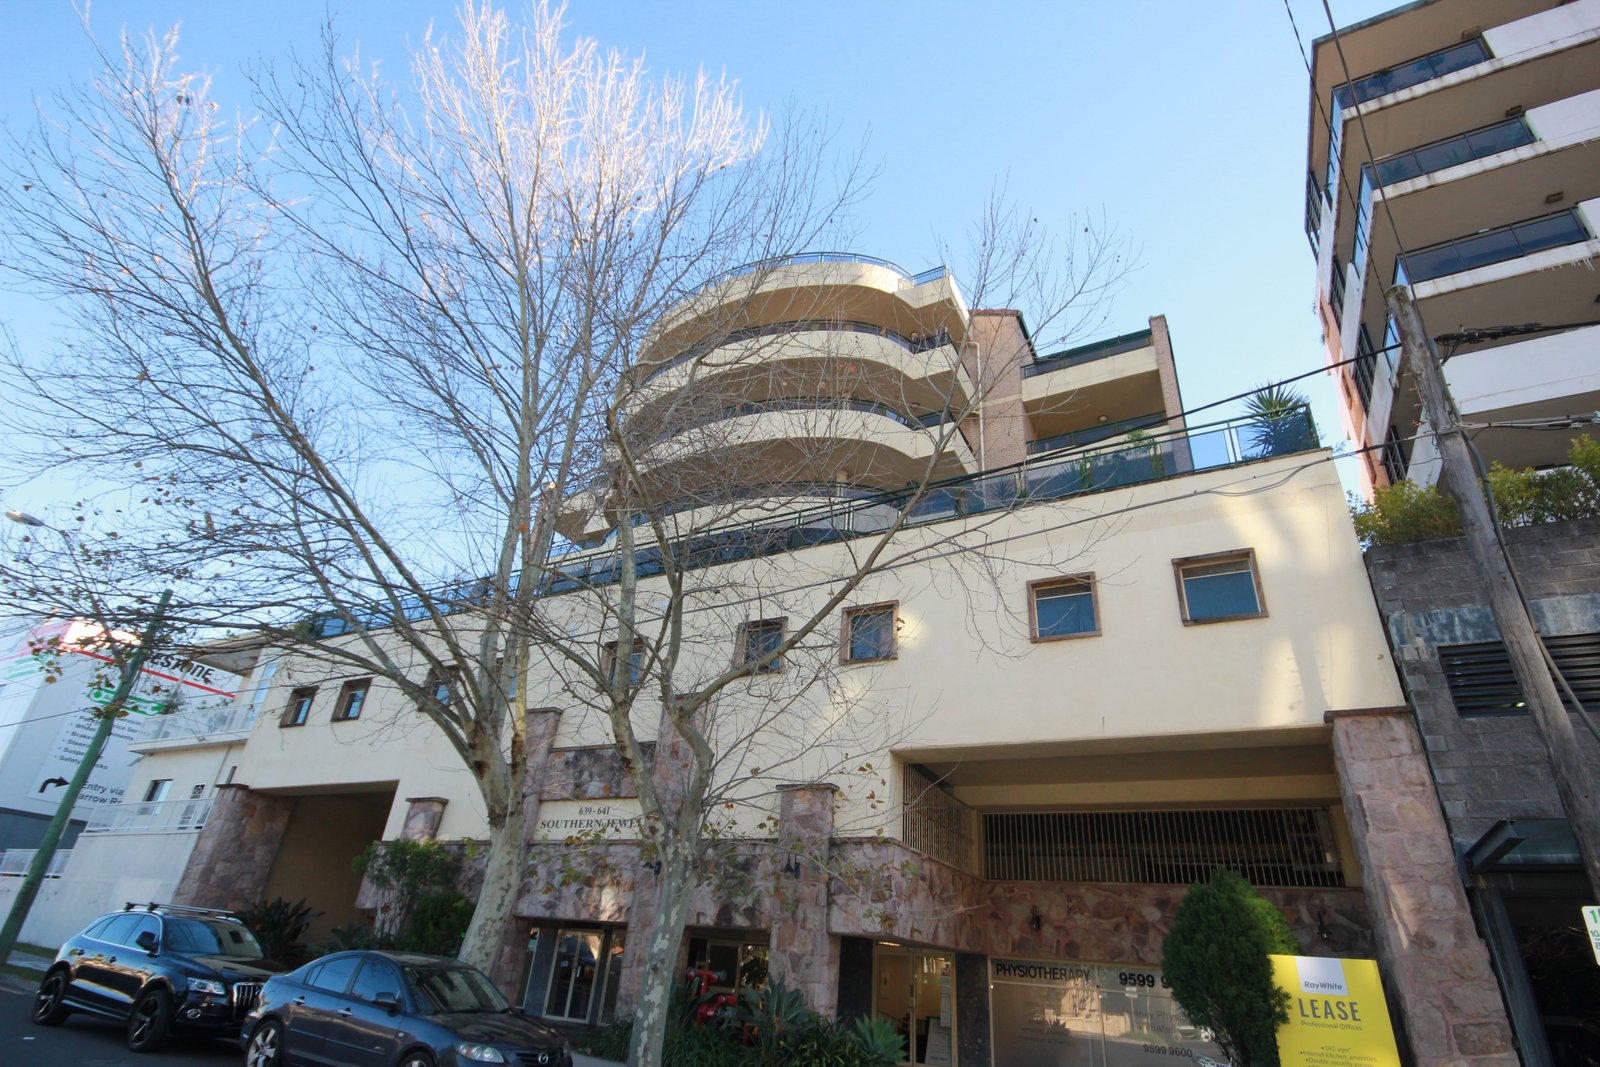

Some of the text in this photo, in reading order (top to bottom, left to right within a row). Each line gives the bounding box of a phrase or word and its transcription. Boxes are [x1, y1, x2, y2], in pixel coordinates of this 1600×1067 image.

[110, 786, 124, 796] via
[79, 793, 108, 804] arrow
[578, 806, 610, 816] 639-641
[540, 818, 602, 829] SOUTHERN
[996, 963, 1090, 981] PHYSIOTHERAPY
[1119, 972, 1155, 988] 9599
[1304, 981, 1343, 991] RayWhite
[1298, 998, 1362, 1022] LEASE
[1301, 1020, 1363, 1031] Professional Offices
[1143, 1044, 1193, 1058] 9599 9600
